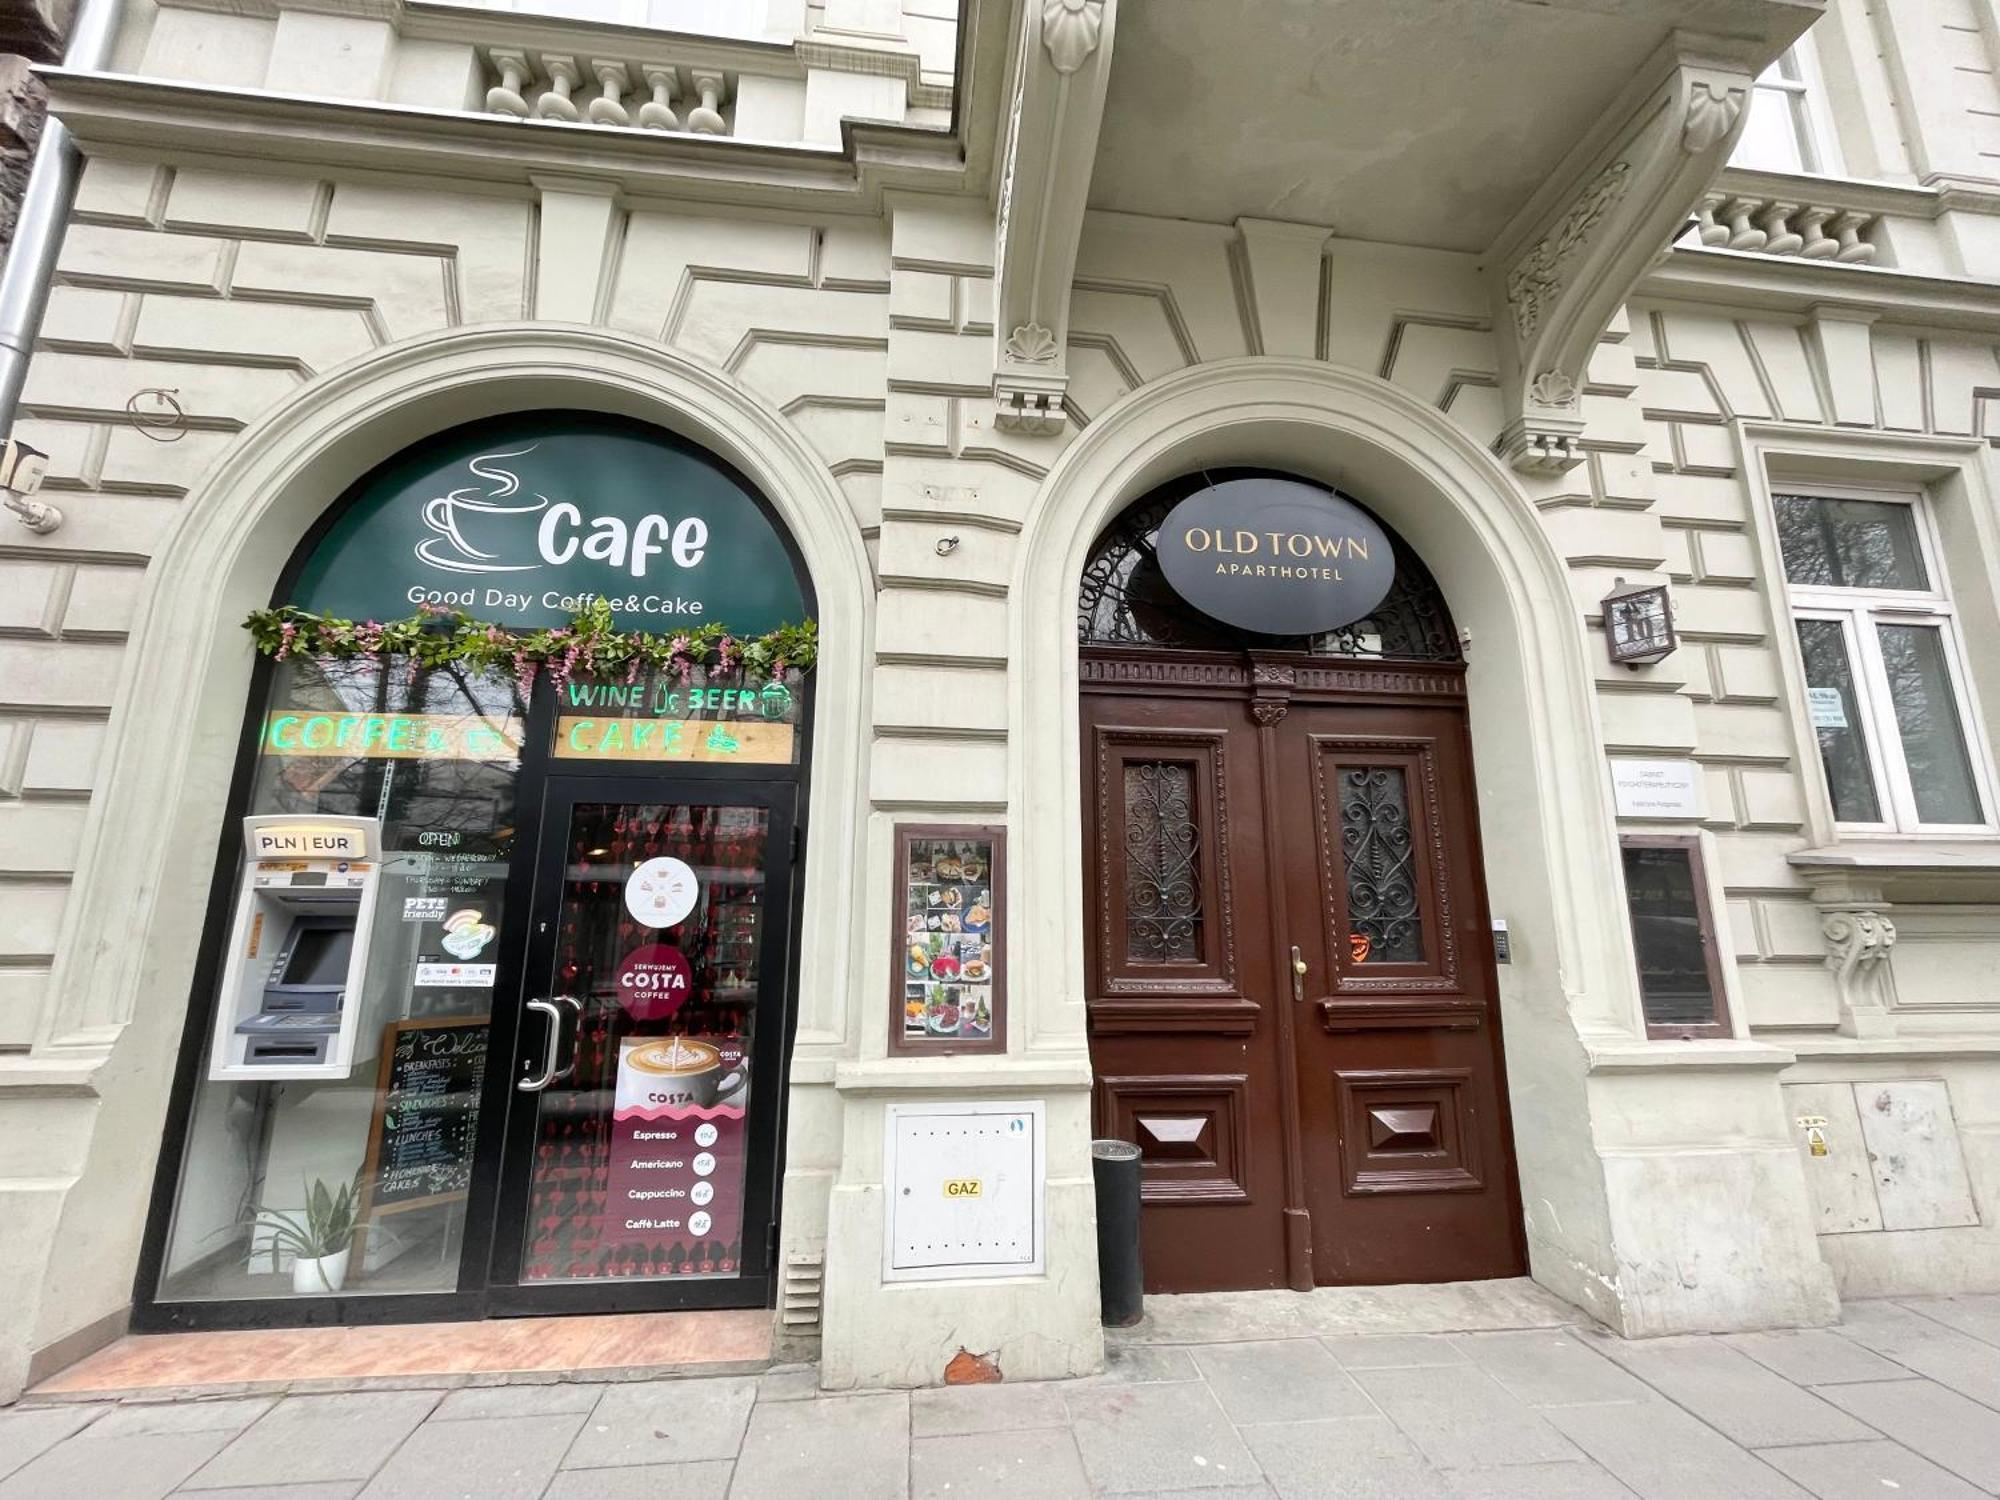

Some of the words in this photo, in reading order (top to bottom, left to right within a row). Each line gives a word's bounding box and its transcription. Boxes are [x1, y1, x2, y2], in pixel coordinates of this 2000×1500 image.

[538, 502, 709, 577] Cafe
[1184, 527, 1260, 554] OLD
[1263, 532, 1369, 561] TOWN
[1215, 562, 1344, 581] APARTHOTEL
[406, 585, 475, 606] Good
[484, 588, 533, 612] Day
[568, 684, 646, 708] WINE
[687, 688, 756, 711] BEER
[569, 721, 684, 755] CAKE
[261, 836, 297, 849] PLN
[312, 837, 349, 849] EUR
[634, 963, 677, 972] SERWUJEMY
[621, 972, 686, 990] COSTA
[634, 991, 670, 1000] COFFEE
[648, 1092, 695, 1104] COSTA
[395, 1128, 442, 1146] LUNCHES
[633, 1130, 678, 1141] Espresso
[630, 1159, 684, 1169] Americano
[383, 1178, 421, 1193] CAKES
[948, 1182, 979, 1196] GAZ
[627, 1188, 686, 1200] Cappuccino
[653, 1218, 681, 1229] Latte
